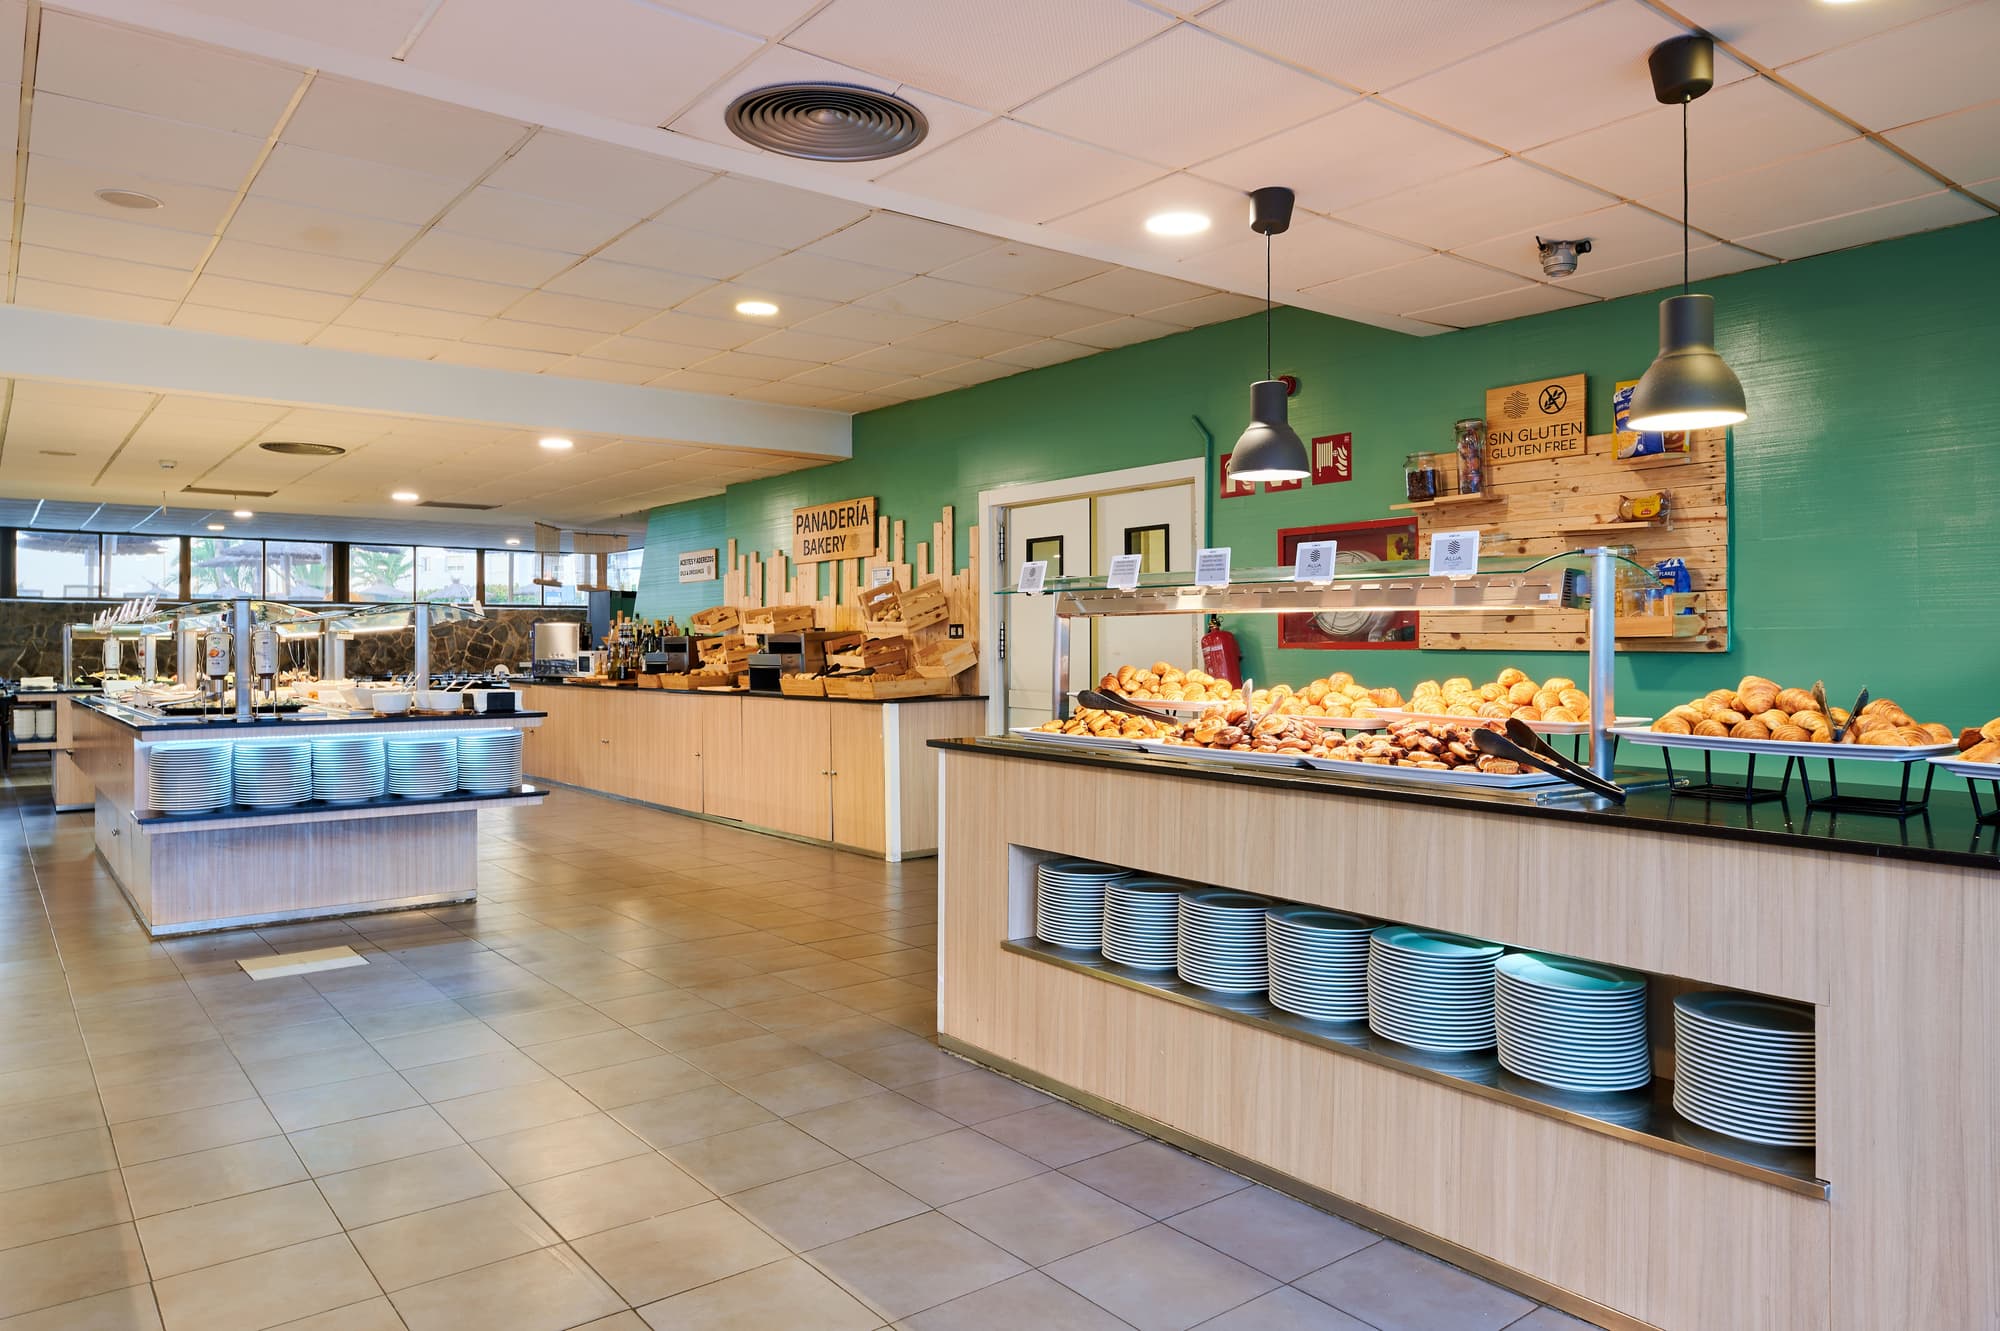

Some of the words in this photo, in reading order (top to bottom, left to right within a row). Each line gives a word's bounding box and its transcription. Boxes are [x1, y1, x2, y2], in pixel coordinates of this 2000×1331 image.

[1489, 431, 1513, 446] SIN
[1518, 421, 1583, 442] GLUTEN
[1491, 443, 1541, 459] GLUTEN
[1545, 439, 1577, 452] FREE
[796, 501, 869, 535] PANADERÍA
[803, 535, 847, 556] BAKERY
